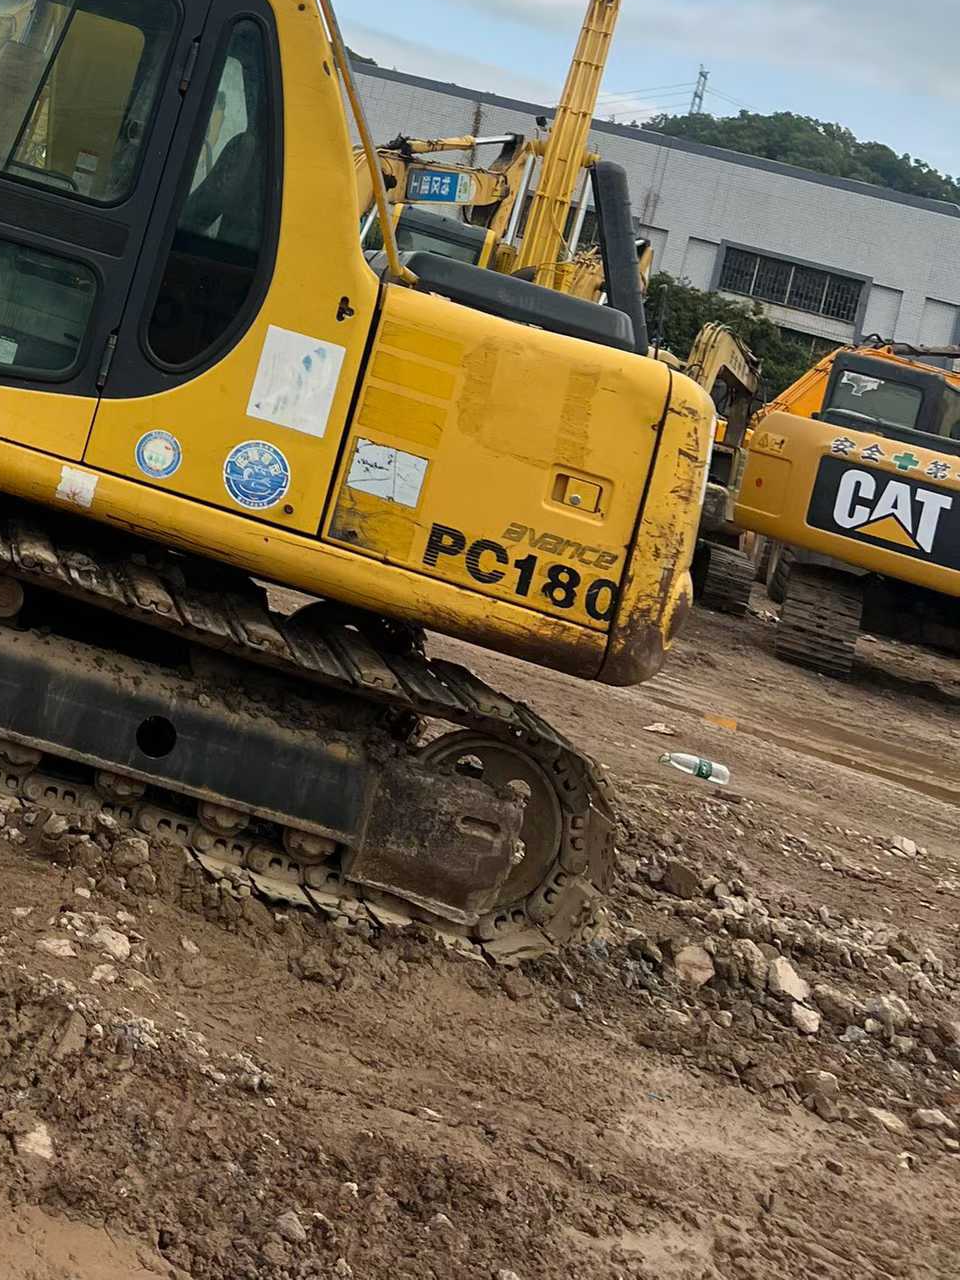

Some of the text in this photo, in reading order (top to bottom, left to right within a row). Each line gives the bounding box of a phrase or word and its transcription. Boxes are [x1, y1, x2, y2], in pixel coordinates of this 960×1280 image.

[501, 522, 619, 570] avance
[833, 469, 953, 553] CAT
[422, 522, 620, 622] PC180
